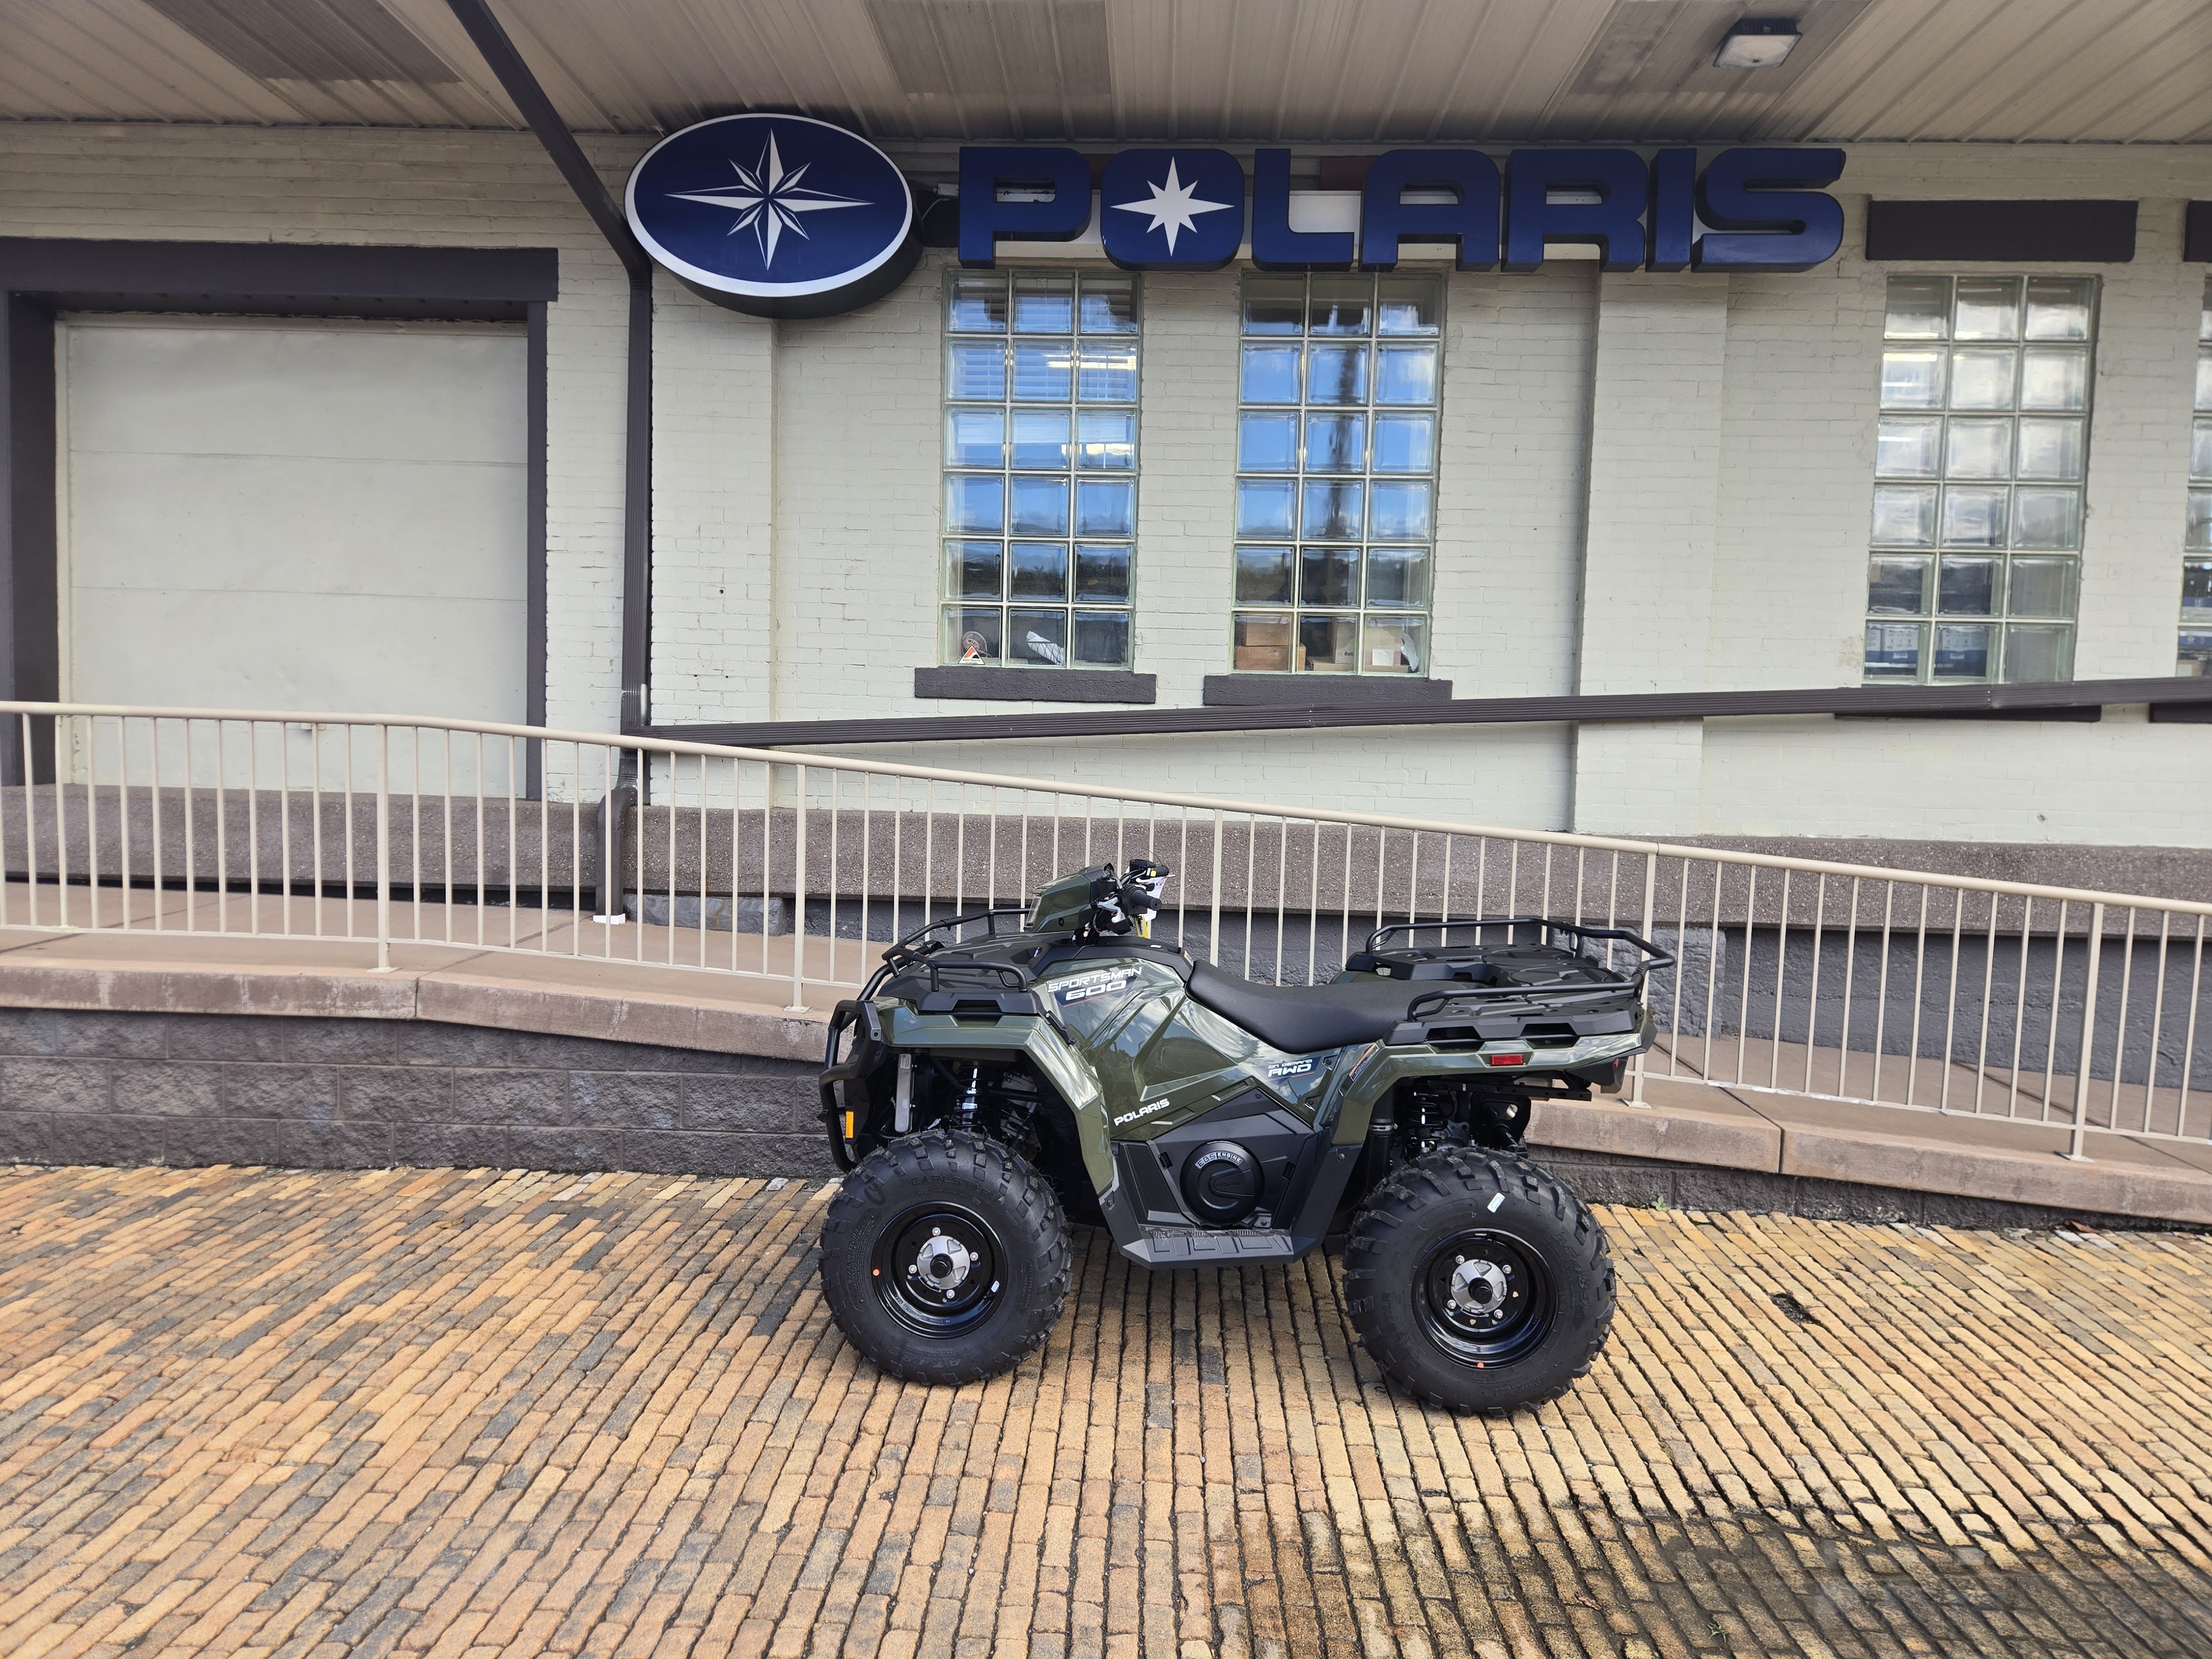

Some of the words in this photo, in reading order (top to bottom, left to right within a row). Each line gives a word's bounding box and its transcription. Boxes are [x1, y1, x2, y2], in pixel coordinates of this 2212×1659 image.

[958, 146, 1846, 272] POLARIS
[1047, 966, 1144, 993] SPORTSMAN
[1065, 979, 1127, 1001] 600
[1267, 1063, 1312, 1077] AWD
[1281, 1059, 1313, 1067] DEMAND
[1114, 1098, 1170, 1126] POLARIS
[1197, 1153, 1216, 1167] EBS
[1217, 1152, 1241, 1163] ENGINE
[911, 1174, 992, 1197] CARLSTAR
